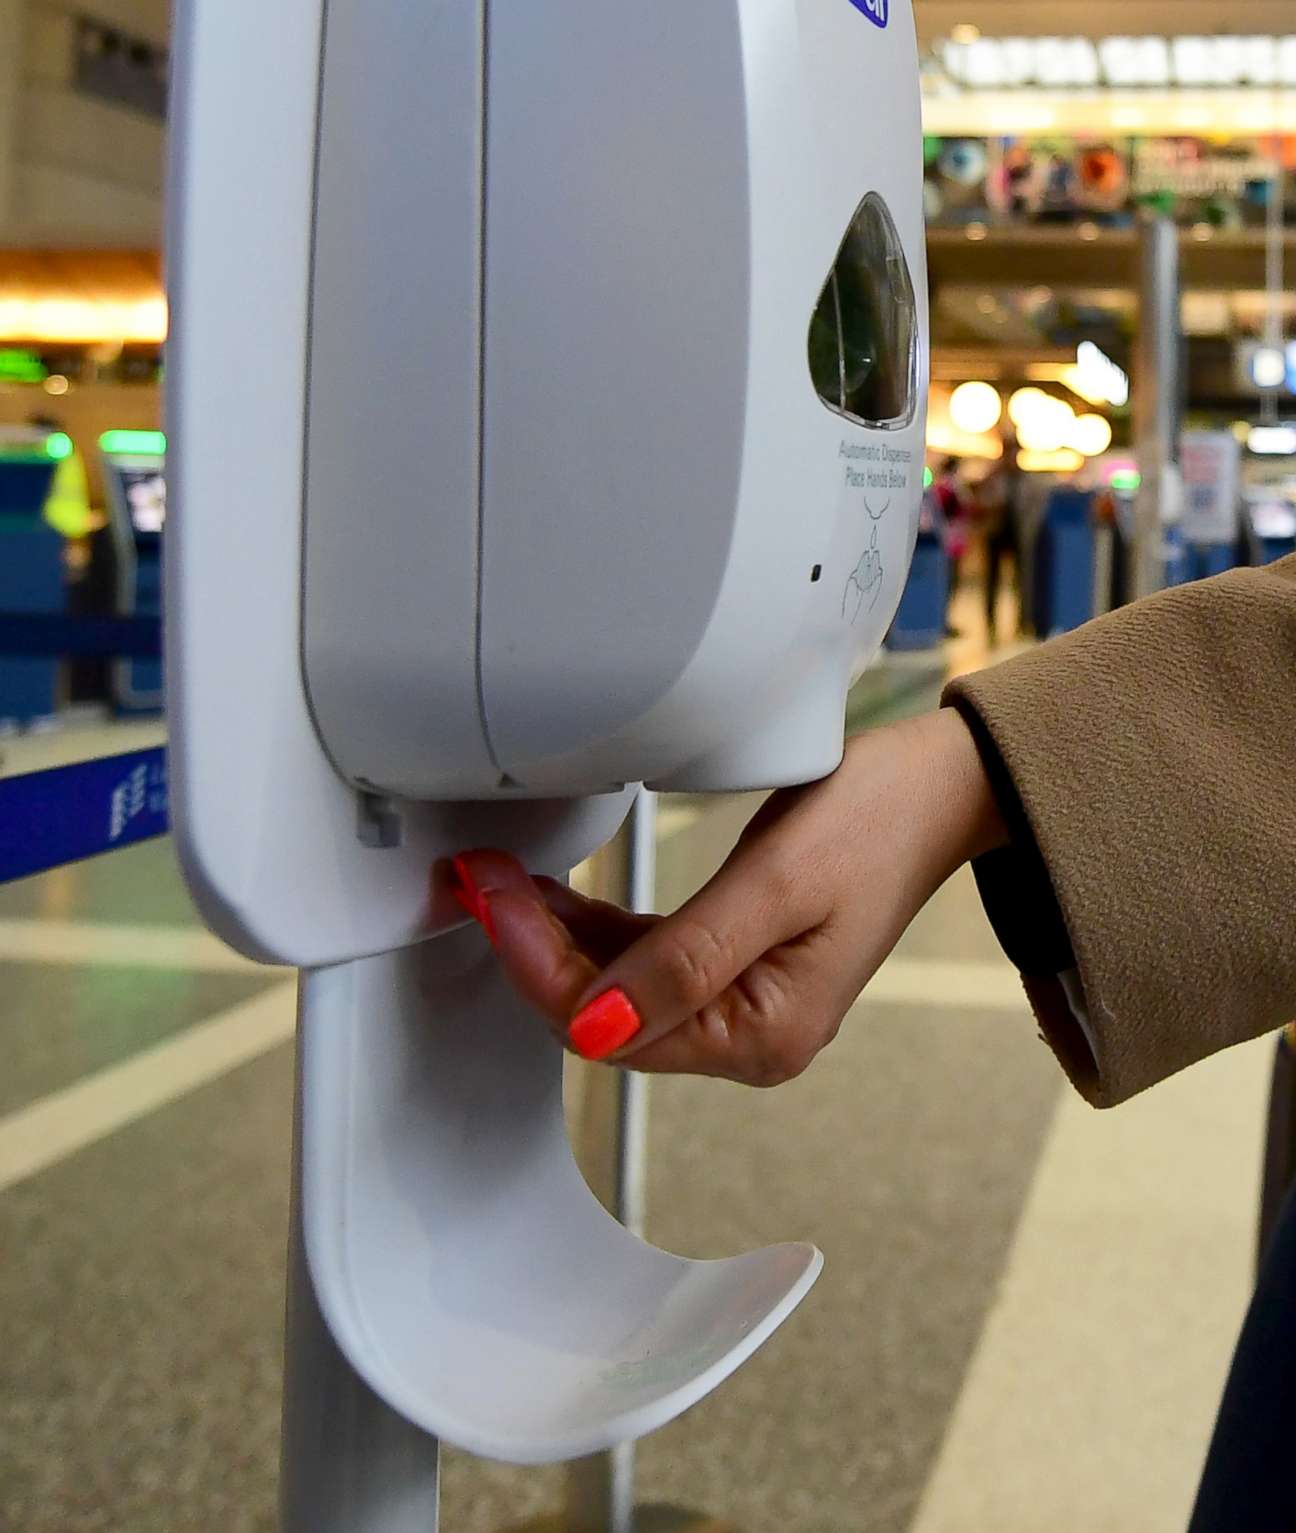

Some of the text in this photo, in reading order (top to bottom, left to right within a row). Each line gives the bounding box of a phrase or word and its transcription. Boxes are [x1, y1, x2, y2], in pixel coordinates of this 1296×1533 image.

[839, 440, 881, 461] Automatic
[845, 466, 906, 488] Place Hands Below
